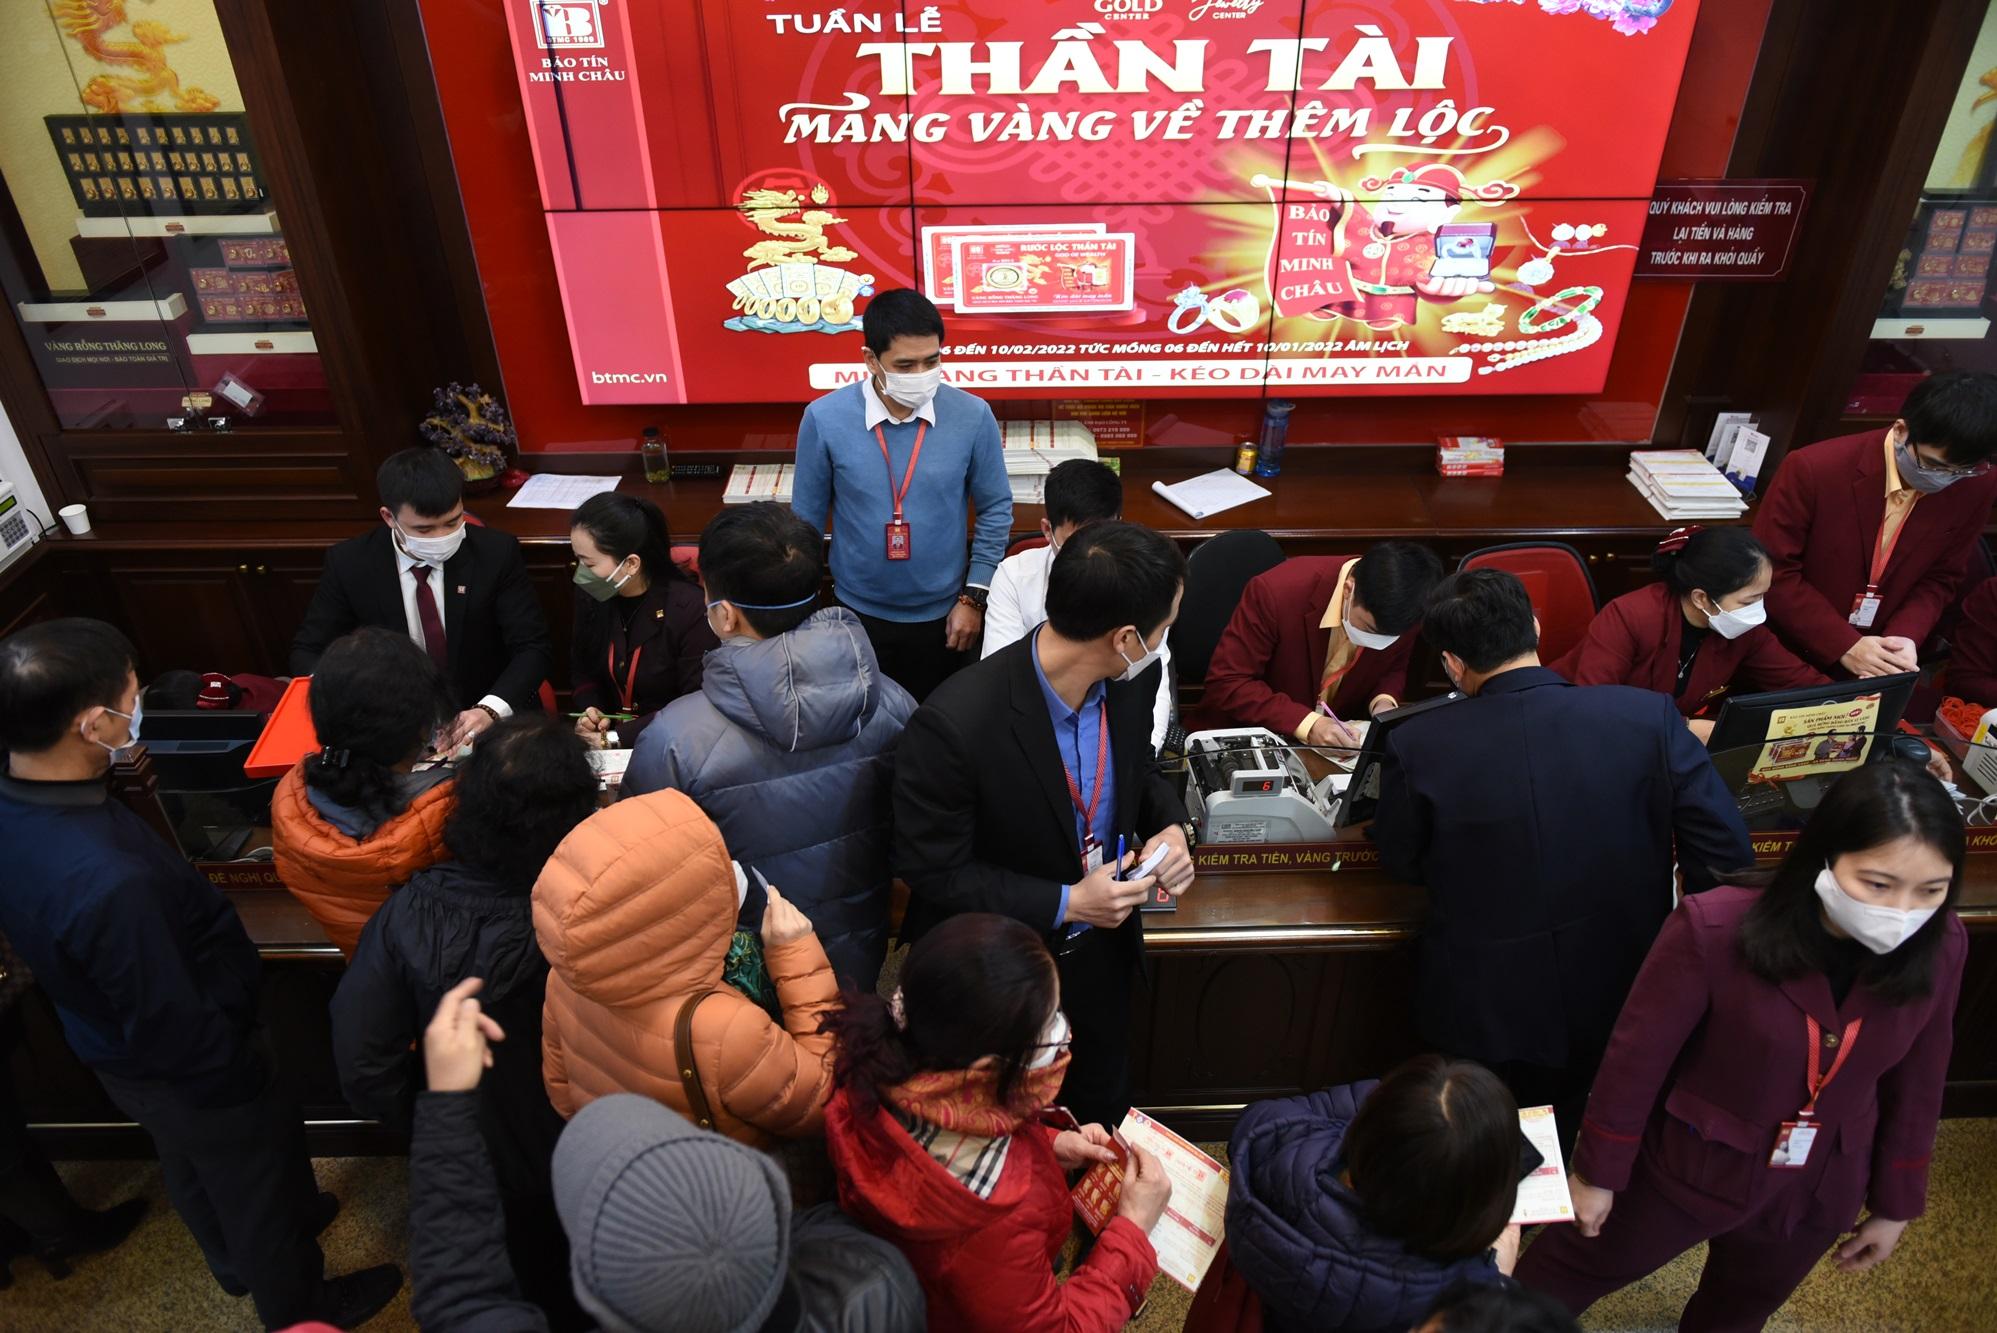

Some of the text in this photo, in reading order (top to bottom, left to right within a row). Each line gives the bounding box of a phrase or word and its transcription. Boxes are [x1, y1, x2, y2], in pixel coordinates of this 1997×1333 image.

[766, 6, 942, 34] TUẦN LỄ
[1212, 12, 1247, 20] CENTER
[541, 55, 608, 68] BẢO TÍN
[856, 22, 1455, 95] THẦN TÀI
[529, 69, 625, 82] MINH CHÂU
[779, 97, 1502, 150] MANG VÀNG VỀ THÊM LỘC
[1288, 203, 1330, 222] BẢO
[1649, 198, 1670, 215] QUÝ
[1670, 198, 1702, 215] KHÁCH
[1704, 201, 1721, 215] VUI
[1722, 199, 1748, 215] LÒNG
[1773, 202, 1792, 215] TRA
[1291, 228, 1327, 246] TÍN
[1673, 227, 1689, 244] LẠI
[1280, 257, 1334, 273] MINH
[1682, 252, 1698, 265] KHI
[1699, 252, 1712, 265] RA
[1280, 279, 1343, 301] CHÂU
[140, 341, 168, 351] LONG
[953, 342, 986, 355] ĐẾN
[991, 344, 1076, 355] 10/02/2022
[1079, 341, 1110, 354] TỨC
[1164, 343, 1184, 353] 06
[1186, 340, 1220, 354] ĐẾN
[1221, 340, 1254, 353] HẾT
[1256, 341, 1343, 353] 10/01/2022
[1373, 340, 1410, 353] LỊCH
[592, 371, 668, 384] btmc.vn
[1098, 365, 1143, 382] TÀI
[1170, 365, 1230, 381] KÉO
[1240, 365, 1292, 380] DÀI
[1302, 366, 1367, 379] MAY
[1262, 781, 1271, 791] 6
[1232, 853, 1257, 865] TRA
[1296, 849, 1330, 863] VÀNG
